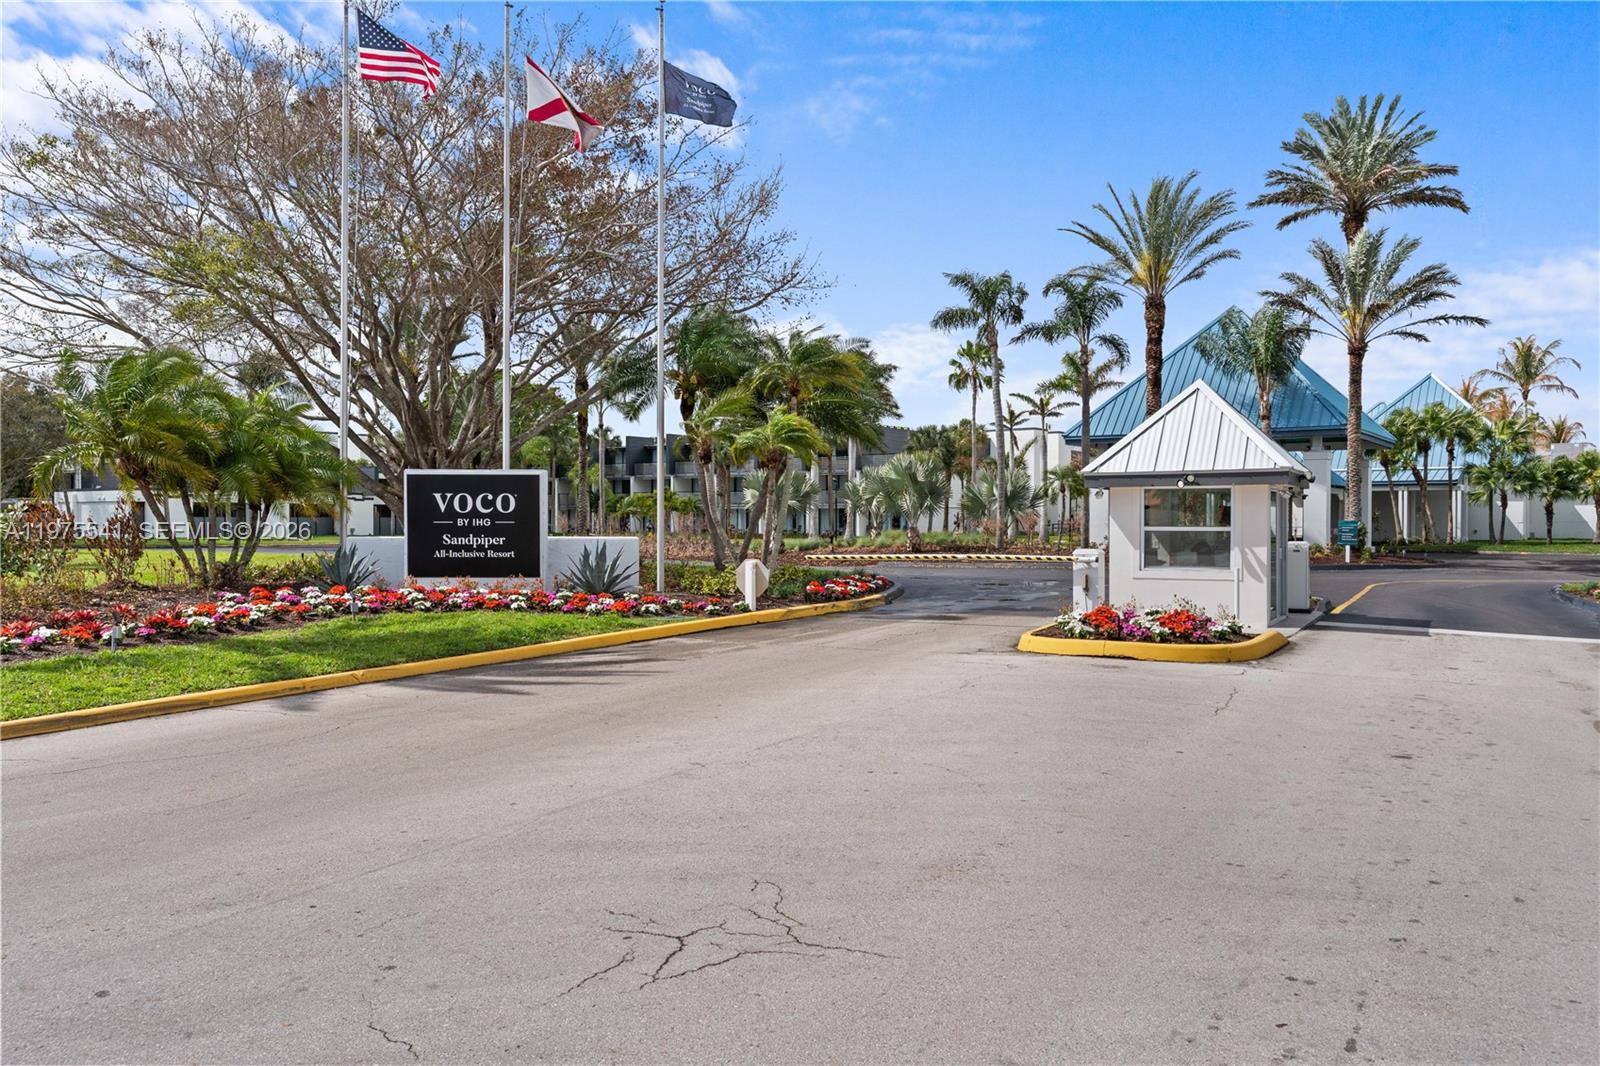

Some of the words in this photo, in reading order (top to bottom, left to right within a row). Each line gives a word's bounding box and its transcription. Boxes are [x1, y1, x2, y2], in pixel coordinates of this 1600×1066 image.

[432, 492, 516, 514] VOCO
[457, 518, 470, 527] BY
[472, 518, 491, 527] IHG
[442, 534, 506, 548] Sandpiper
[433, 549, 485, 558] All-Inclusive
[487, 549, 515, 558] Resort
